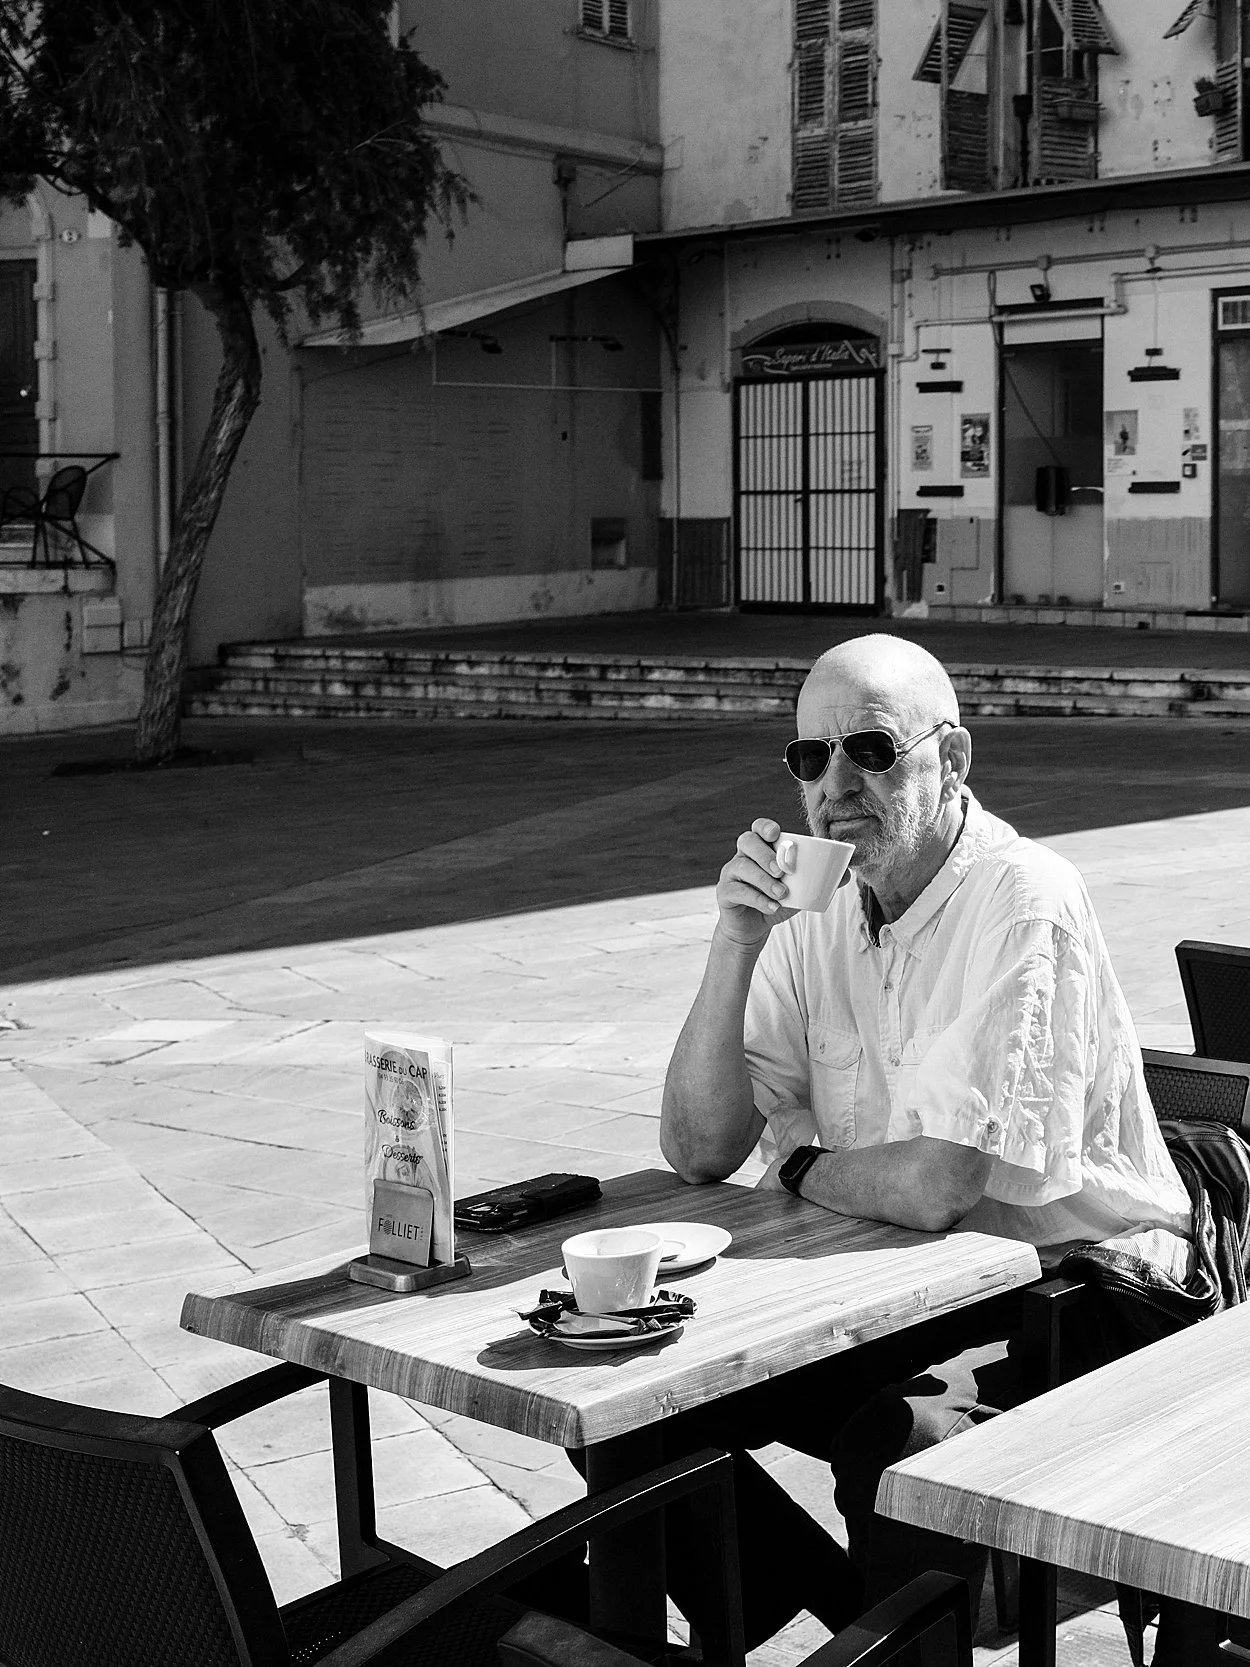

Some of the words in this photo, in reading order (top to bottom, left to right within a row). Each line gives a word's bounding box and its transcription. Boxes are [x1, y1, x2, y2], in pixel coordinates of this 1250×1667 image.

[364, 1049, 398, 1074] RASSERIE
[398, 1066, 408, 1076] DU
[408, 1065, 428, 1080] CAP
[377, 1109, 415, 1131] Boissons
[381, 1144, 424, 1165] Desserts
[378, 1217, 420, 1241] FOLLIET
